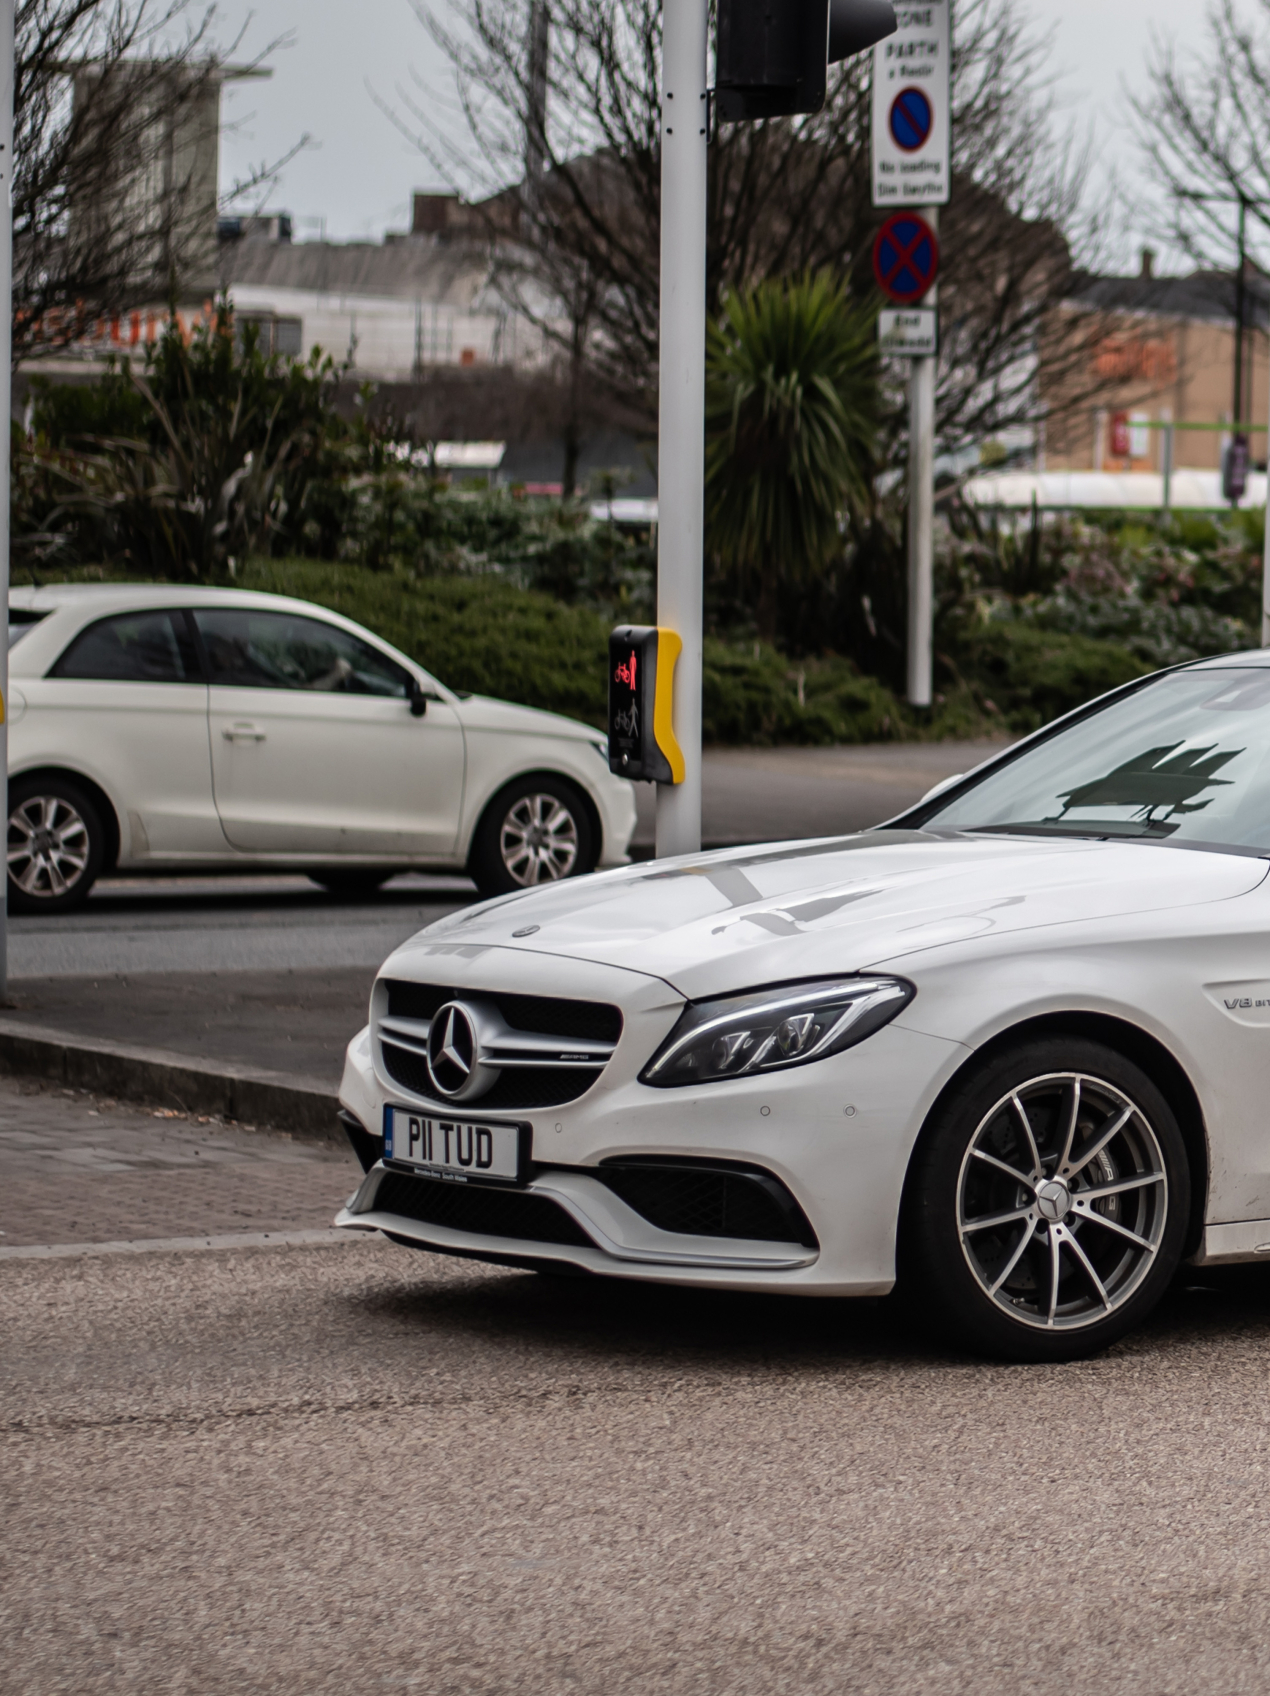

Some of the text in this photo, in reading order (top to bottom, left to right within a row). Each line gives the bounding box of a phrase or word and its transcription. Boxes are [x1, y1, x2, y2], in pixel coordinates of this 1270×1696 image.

[894, 9, 933, 28] ONE
[880, 161, 895, 173] No
[894, 314, 921, 326] End
[1223, 998, 1253, 1009] V8
[439, 1122, 493, 1169] TUD
